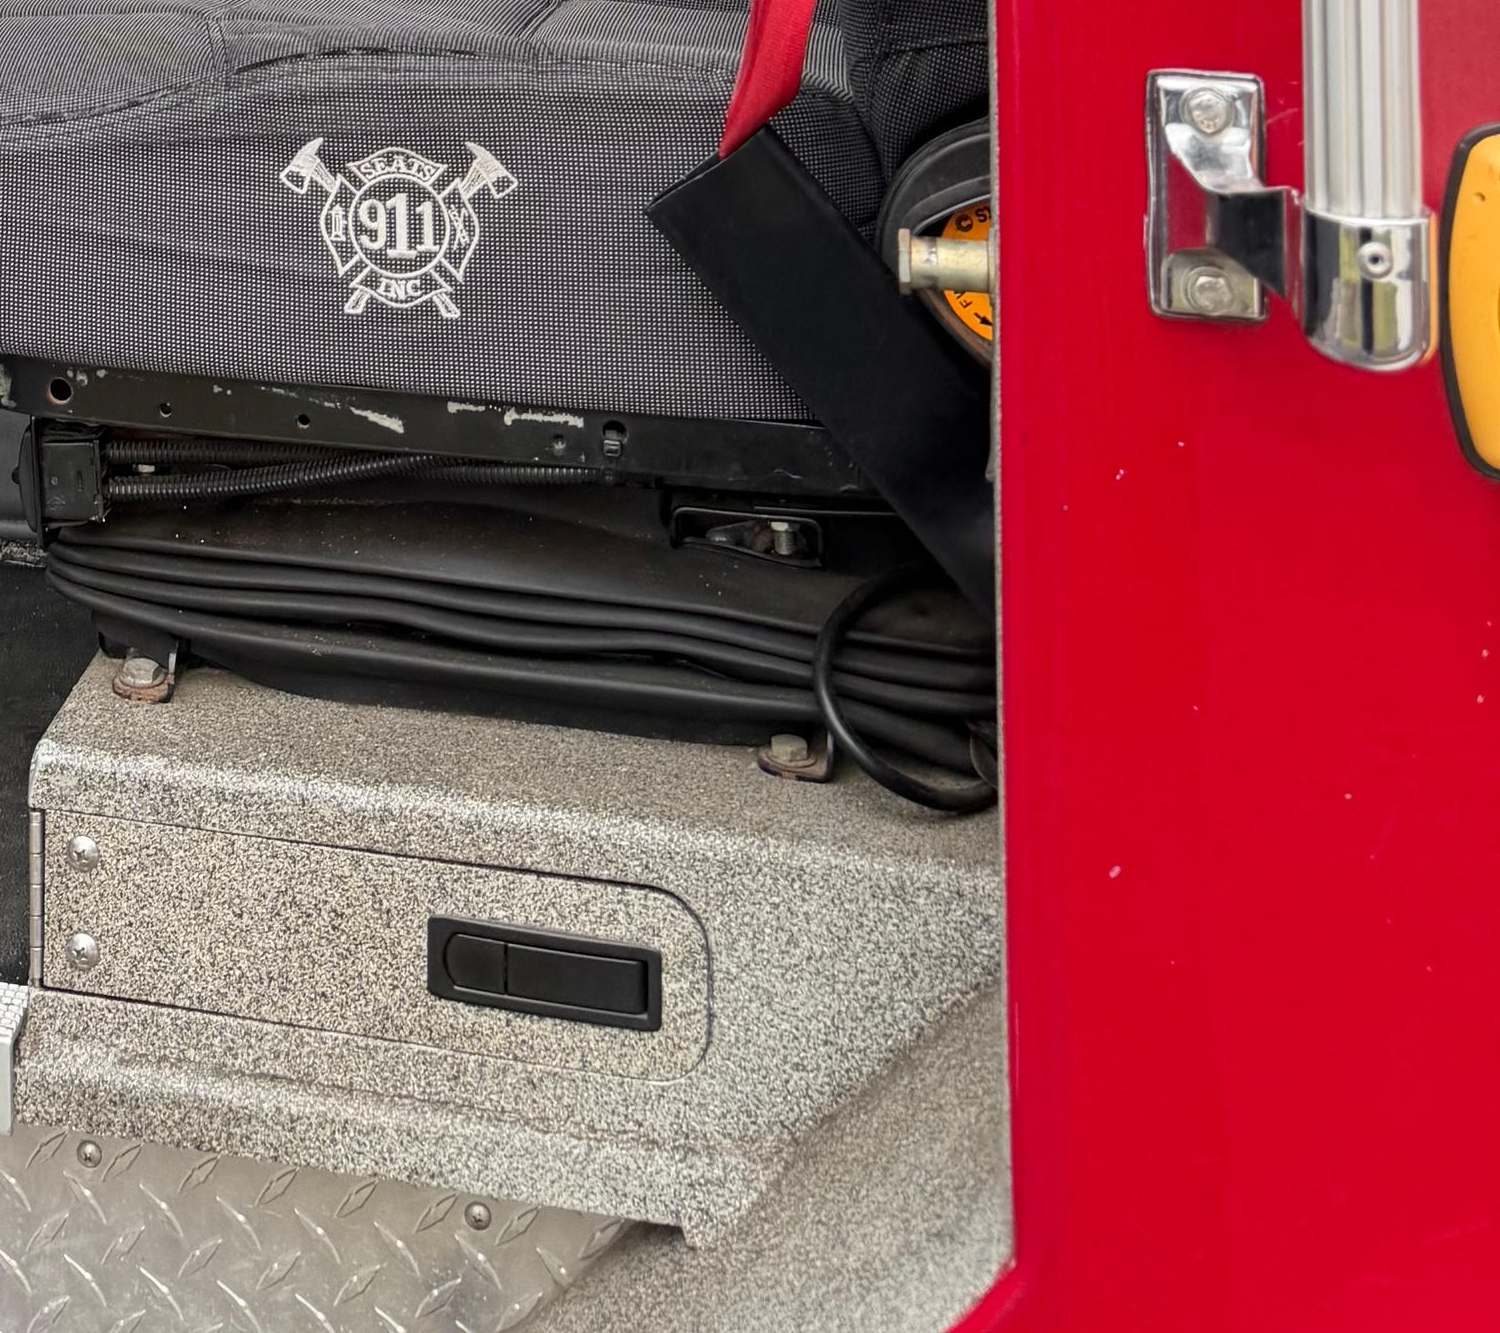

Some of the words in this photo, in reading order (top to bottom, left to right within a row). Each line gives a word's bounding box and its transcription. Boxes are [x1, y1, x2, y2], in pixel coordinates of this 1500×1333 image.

[360, 155, 434, 183] SEATS
[359, 192, 440, 259] 911
[377, 277, 422, 300] INC
